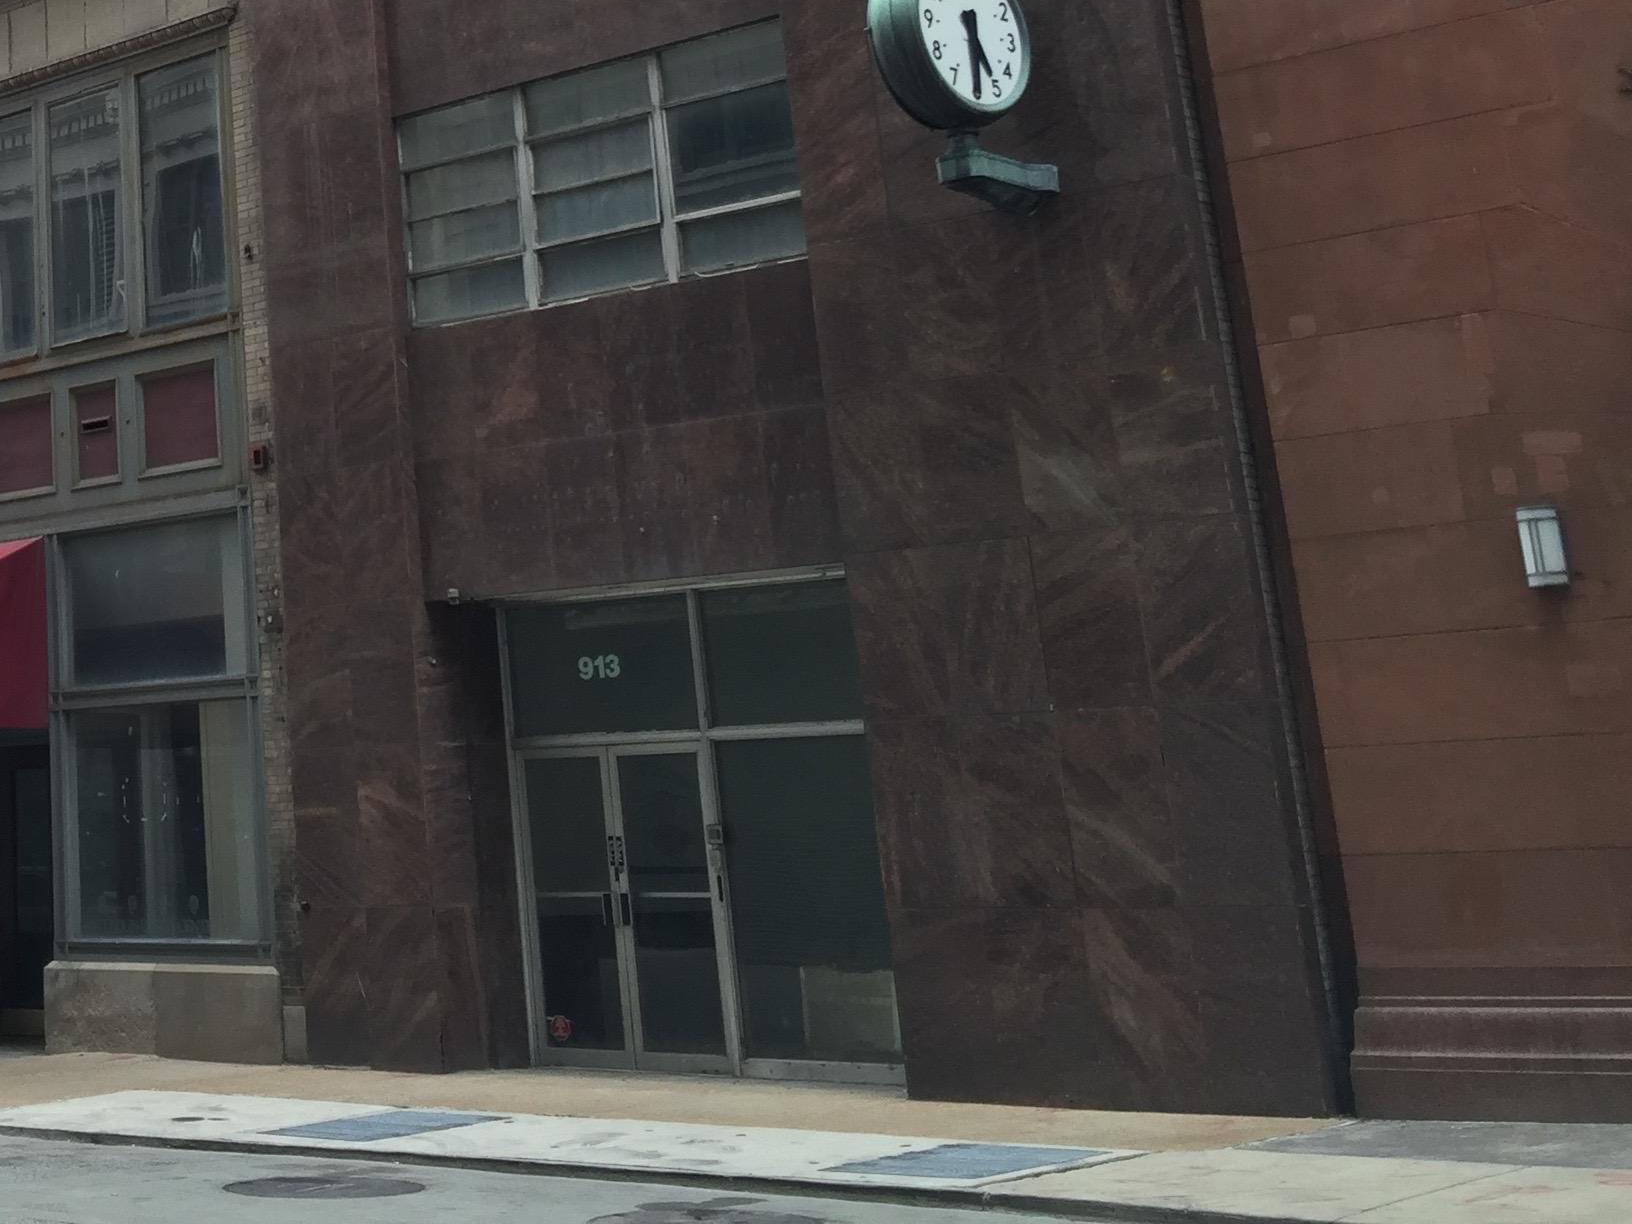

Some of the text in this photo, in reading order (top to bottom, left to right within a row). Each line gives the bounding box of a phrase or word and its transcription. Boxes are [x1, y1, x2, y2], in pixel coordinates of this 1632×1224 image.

[924, 9, 933, 28] 9
[998, 2, 1009, 22] 2
[932, 40, 942, 60] 8
[1007, 33, 1016, 53] 3
[949, 66, 958, 86] 7
[1002, 62, 1013, 80] 4
[992, 79, 1002, 98] 5
[578, 654, 621, 681] 913
